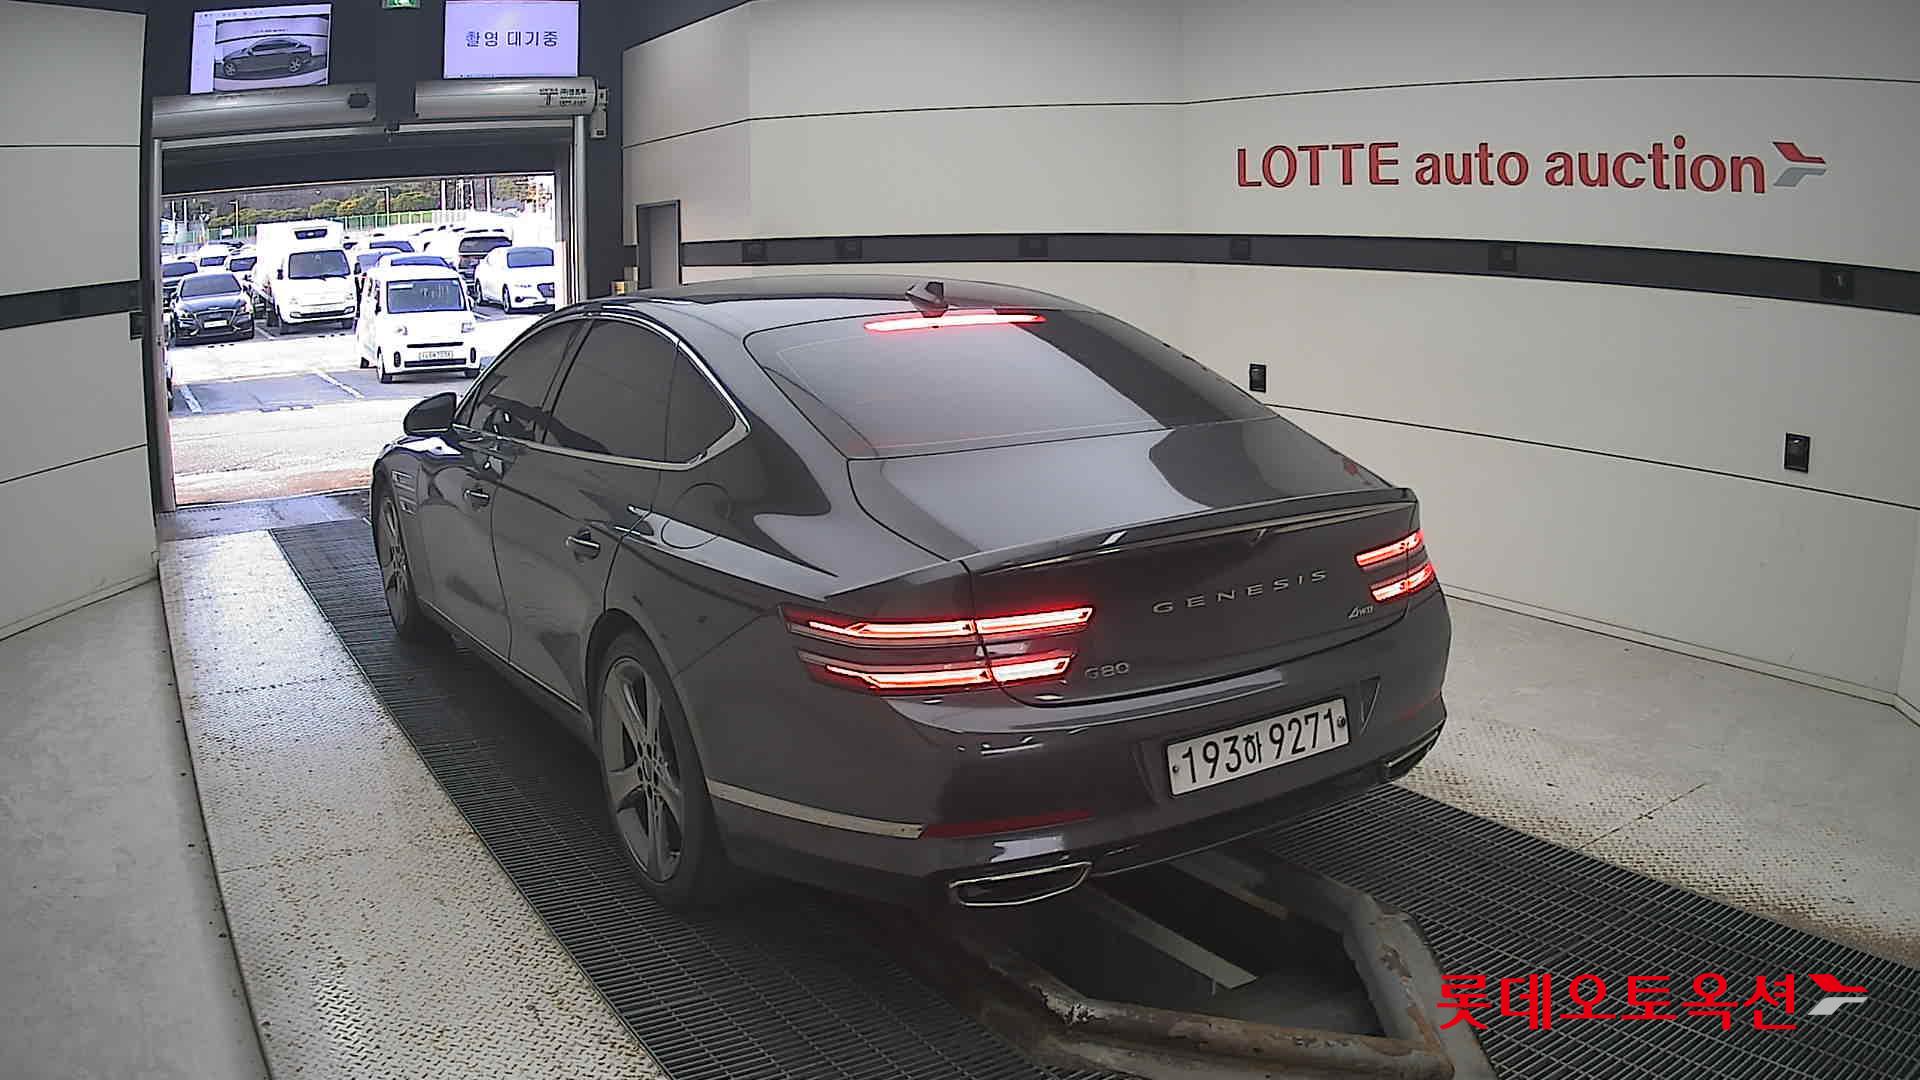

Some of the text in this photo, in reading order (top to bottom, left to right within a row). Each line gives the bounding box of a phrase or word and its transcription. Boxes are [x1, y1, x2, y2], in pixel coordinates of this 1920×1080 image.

[507, 31, 560, 48] 대기중
[1237, 135, 1767, 194] LOTTE auto auction
[1152, 569, 1328, 613] GENESIS
[1085, 662, 1129, 679] G80
[1182, 708, 1336, 783] 193하 9271
